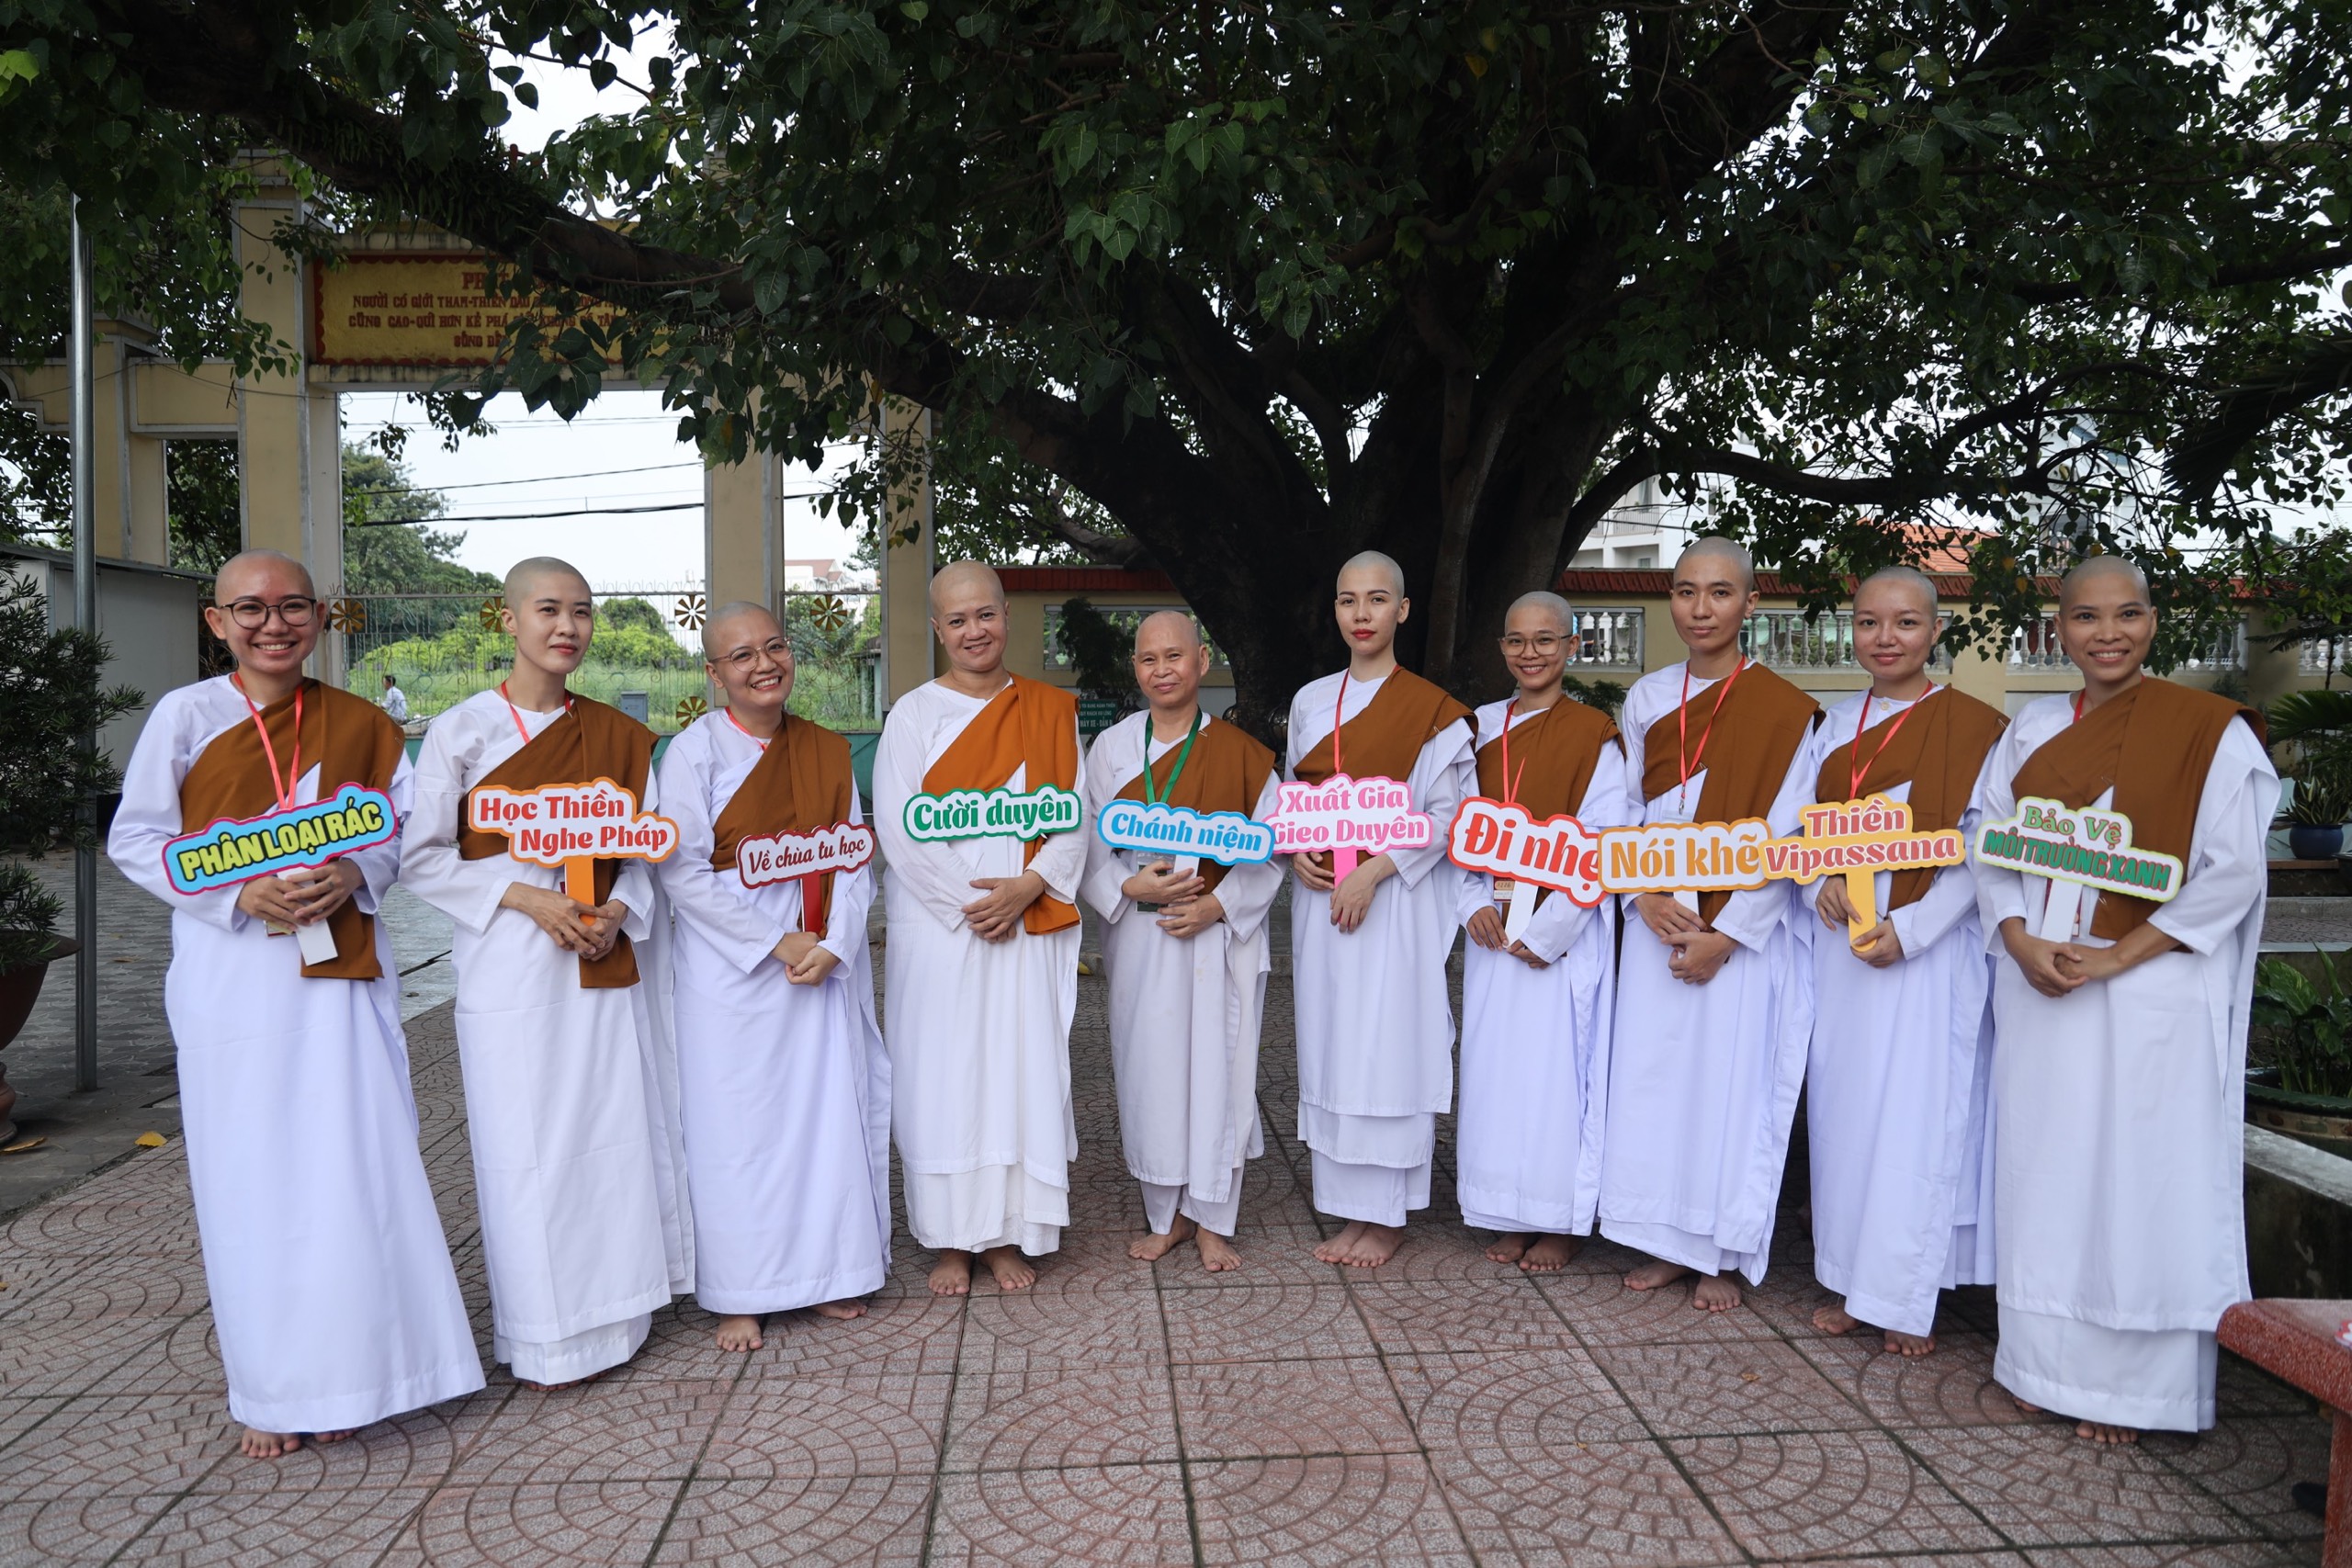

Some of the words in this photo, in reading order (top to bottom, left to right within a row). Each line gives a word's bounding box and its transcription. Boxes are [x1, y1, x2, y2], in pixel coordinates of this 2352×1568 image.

[393, 292, 408, 309] CÓ
[486, 312, 509, 328] PHÁ
[480, 797, 538, 827] Học
[544, 789, 625, 819] Thiền
[913, 798, 978, 831] Cười
[986, 794, 1072, 831] duyên
[1286, 783, 1351, 813] Xuất
[1357, 785, 1405, 810] Gia
[1111, 812, 1193, 843] Chánh
[1197, 825, 1262, 853] niệm
[1272, 821, 1329, 844] Gieo
[1336, 816, 1425, 846] Duyên
[1806, 798, 1905, 838] Thiền
[2021, 805, 2076, 837] Bảo
[2085, 816, 2122, 851] Vệ
[176, 831, 265, 883] PHÂN
[261, 817, 327, 860] LOẠI
[323, 795, 385, 842] RÁC
[520, 827, 594, 858] Nghe
[600, 823, 669, 852] Pháp
[748, 849, 772, 874] Về
[775, 845, 815, 869] chùa
[818, 840, 836, 860] tu
[839, 835, 866, 859] học
[1464, 812, 1517, 862] Đi
[1520, 830, 1599, 891] nhẹ
[1611, 837, 1676, 879] Nói
[1686, 833, 1760, 876] khẽ
[1765, 837, 1958, 877] Vipassana
[1982, 826, 2025, 861] MÔI
[2023, 835, 2109, 879] TRƯỜNG
[2107, 852, 2172, 892] XANH
